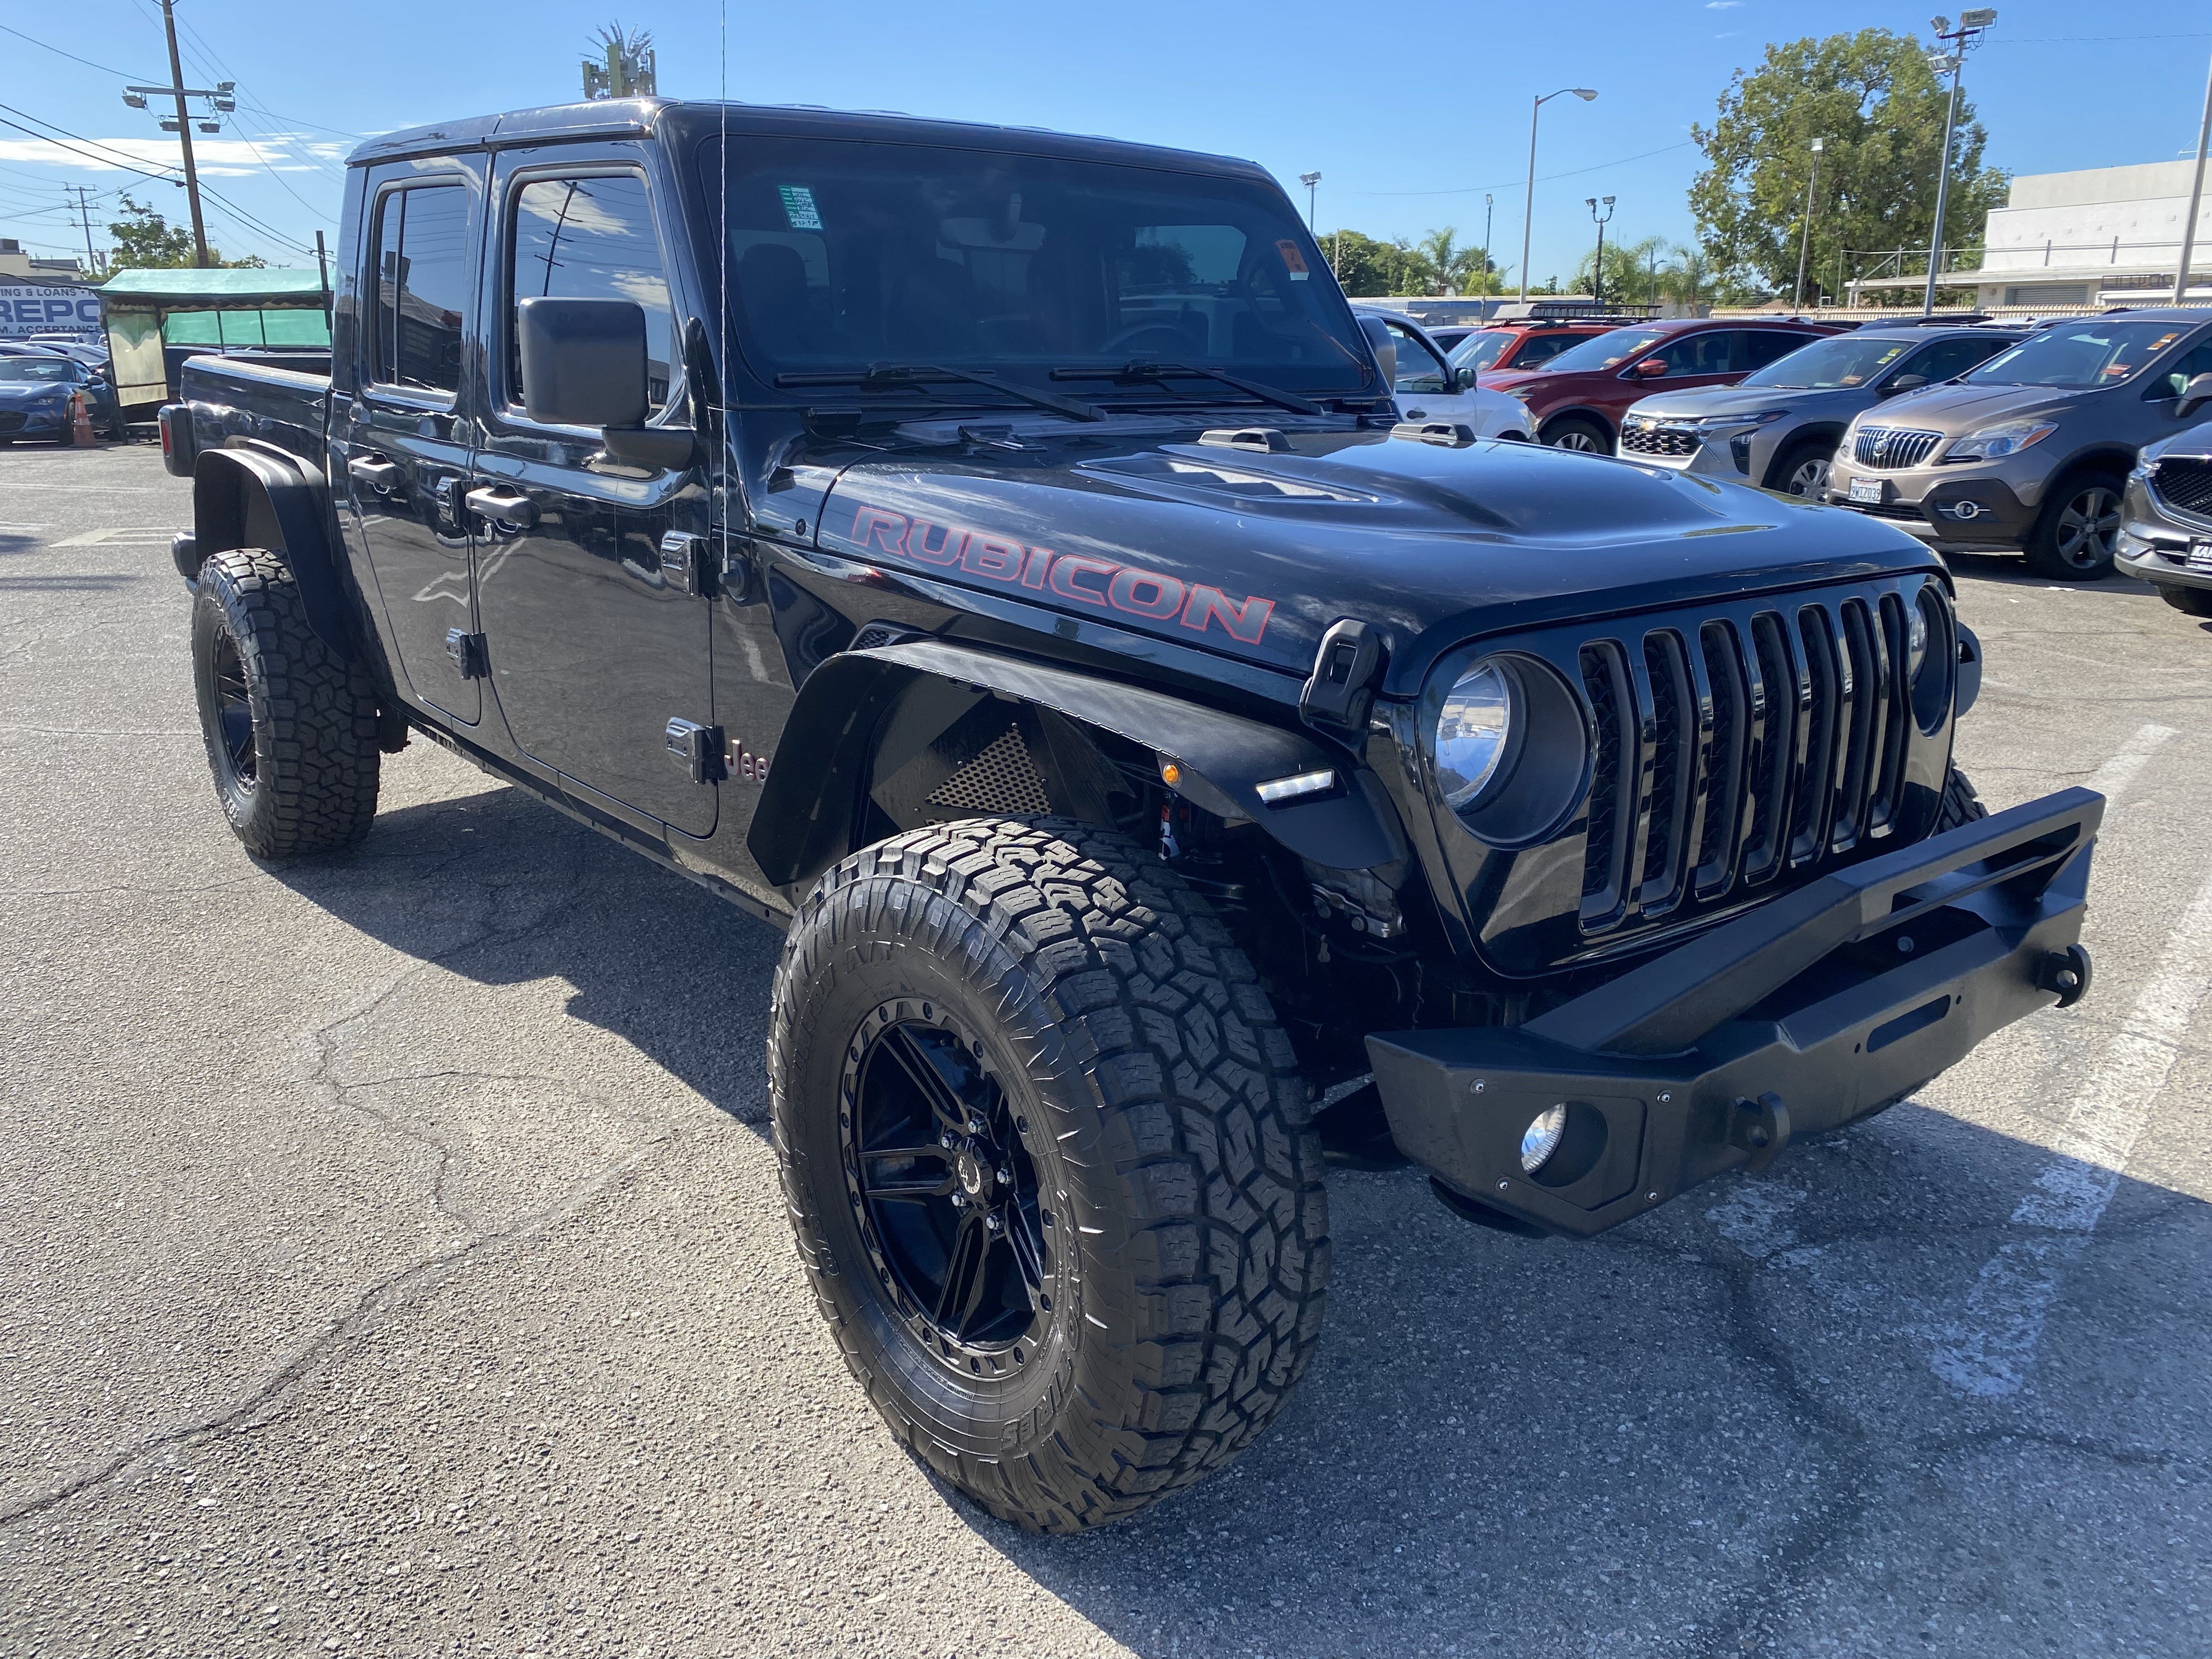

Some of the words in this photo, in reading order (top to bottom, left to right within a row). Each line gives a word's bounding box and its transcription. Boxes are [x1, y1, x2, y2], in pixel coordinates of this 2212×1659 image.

[18, 325, 102, 334] ACCEPTANCE
[851, 506, 1276, 645] RUBICON
[793, 961, 836, 1138] COUNTRY
[1001, 1350, 1073, 1450] TIRES
